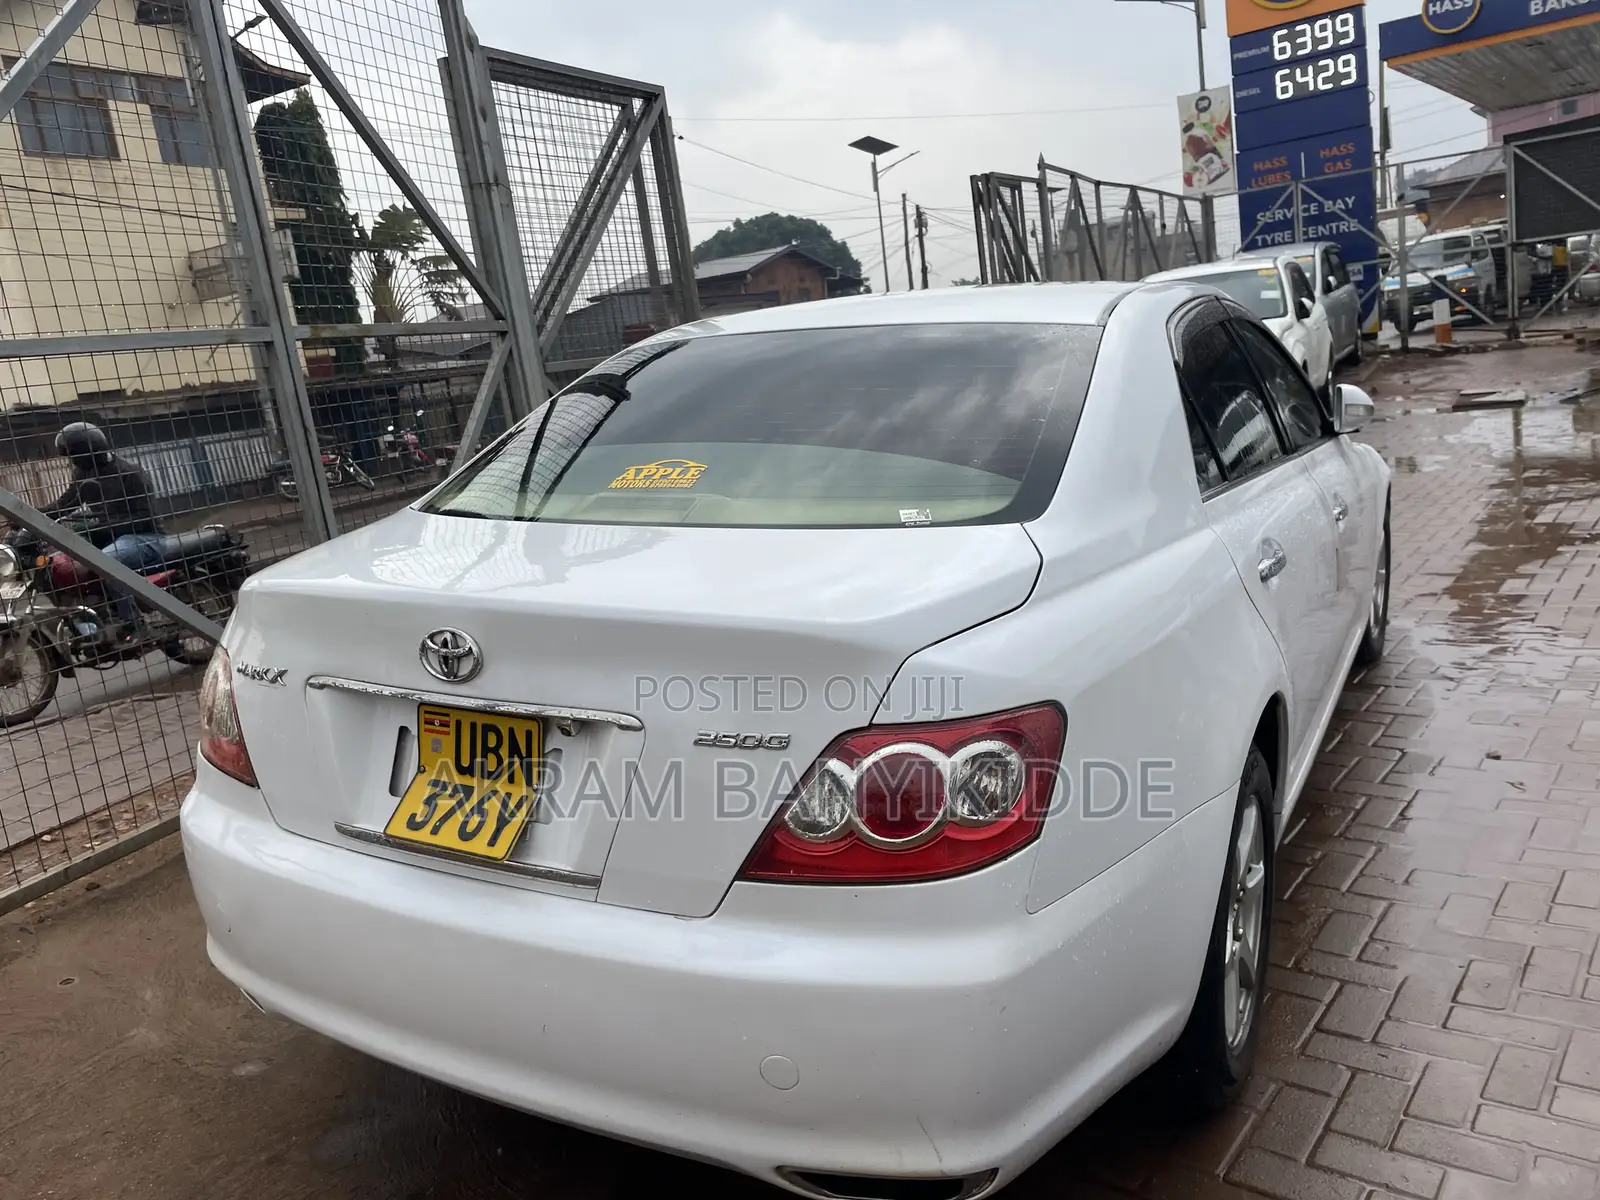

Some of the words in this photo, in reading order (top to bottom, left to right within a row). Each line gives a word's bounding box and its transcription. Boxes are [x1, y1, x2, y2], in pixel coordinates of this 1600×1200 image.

[1428, 0, 1474, 16] HASS
[1529, 0, 1591, 16] BAK
[1233, 45, 1270, 60] PREMIUM
[1272, 12, 1355, 61] 6399
[1235, 87, 1262, 99] DIESEL
[1274, 53, 1357, 100] 6429
[1319, 142, 1356, 159] HASS
[1253, 156, 1288, 172] HASS
[1323, 159, 1353, 173] GAS
[1251, 170, 1292, 188] LUBES
[1256, 202, 1319, 225] SERVCE
[1323, 196, 1356, 213] BAY
[1255, 230, 1293, 247] TYRE
[1300, 219, 1360, 240] CENTRE
[615, 467, 706, 480] APPLE
[608, 479, 651, 489] MOTORS
[269, 667, 289, 687] X
[692, 729, 792, 751] 250G
[454, 719, 533, 788] UBN
[406, 778, 529, 847] 376Y
